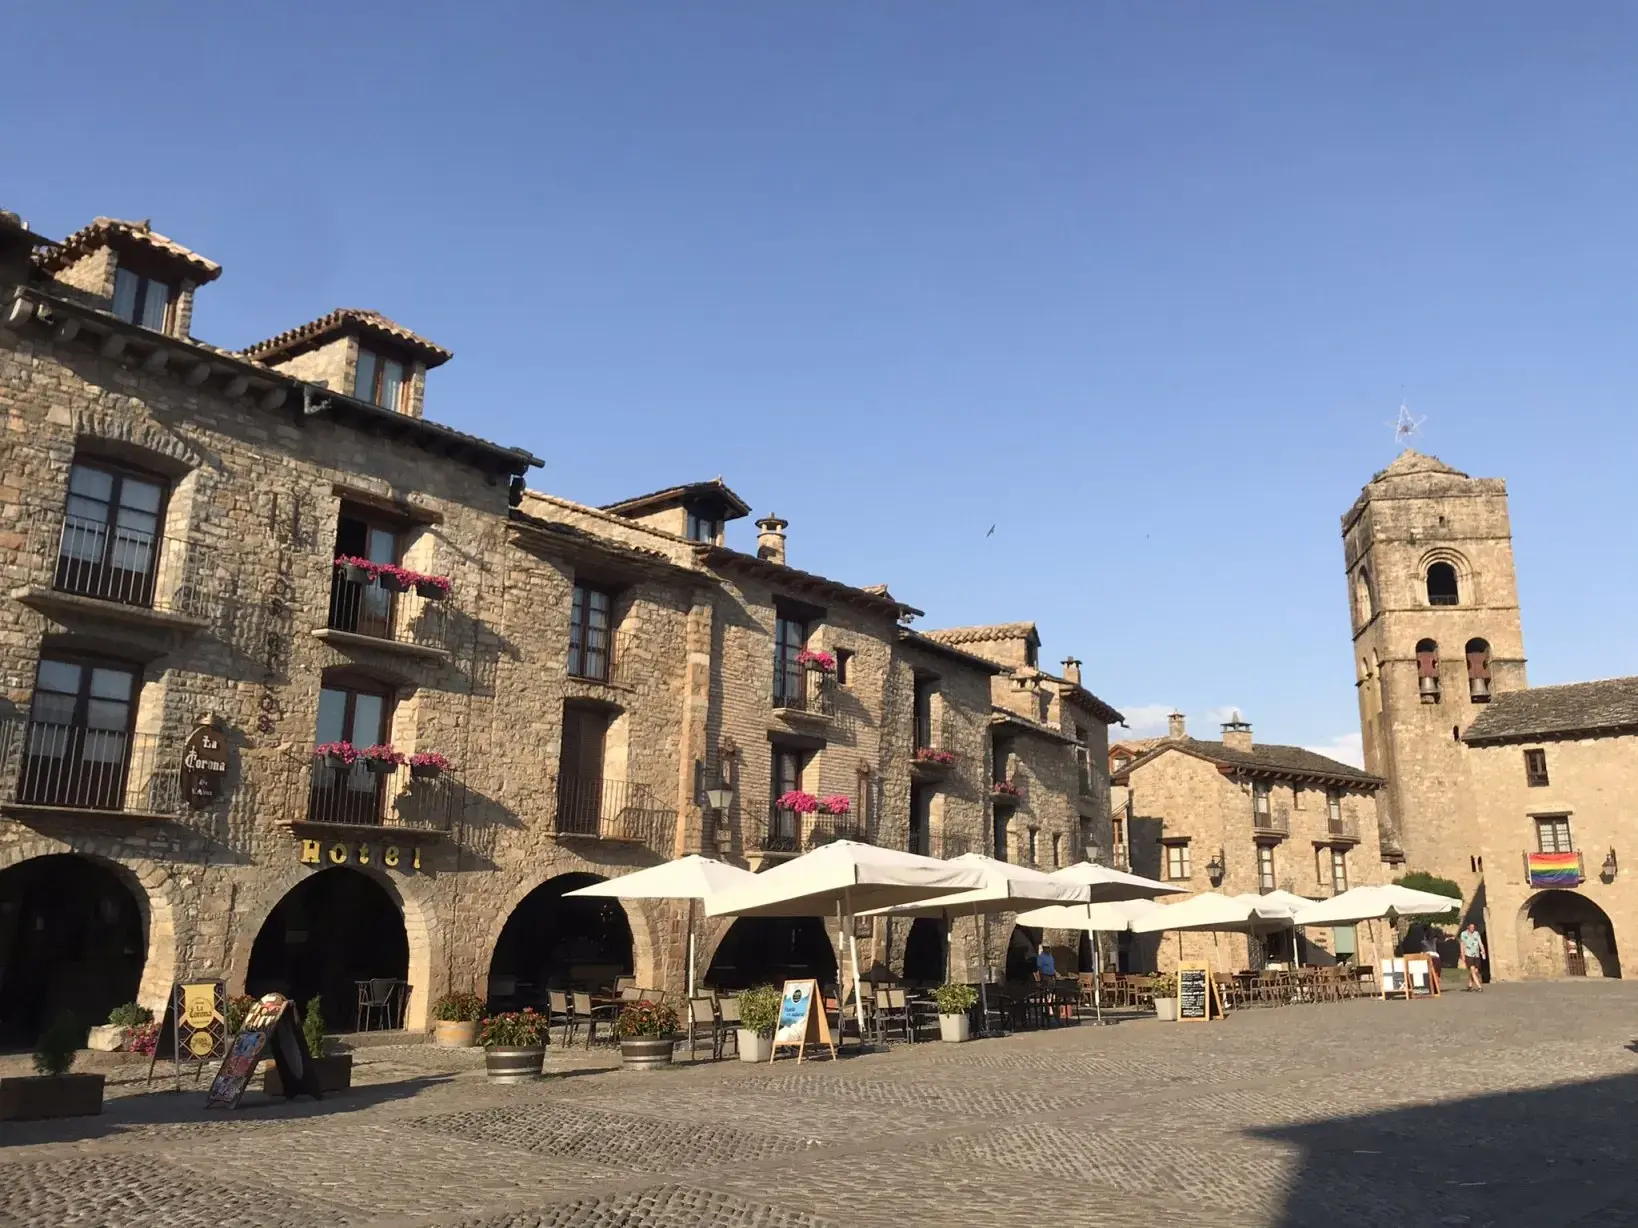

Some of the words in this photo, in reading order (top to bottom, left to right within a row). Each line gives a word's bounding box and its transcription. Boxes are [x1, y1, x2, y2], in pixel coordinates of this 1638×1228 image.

[202, 735, 218, 749] La
[184, 745, 226, 772] Corona
[300, 839, 421, 869] Hotel
